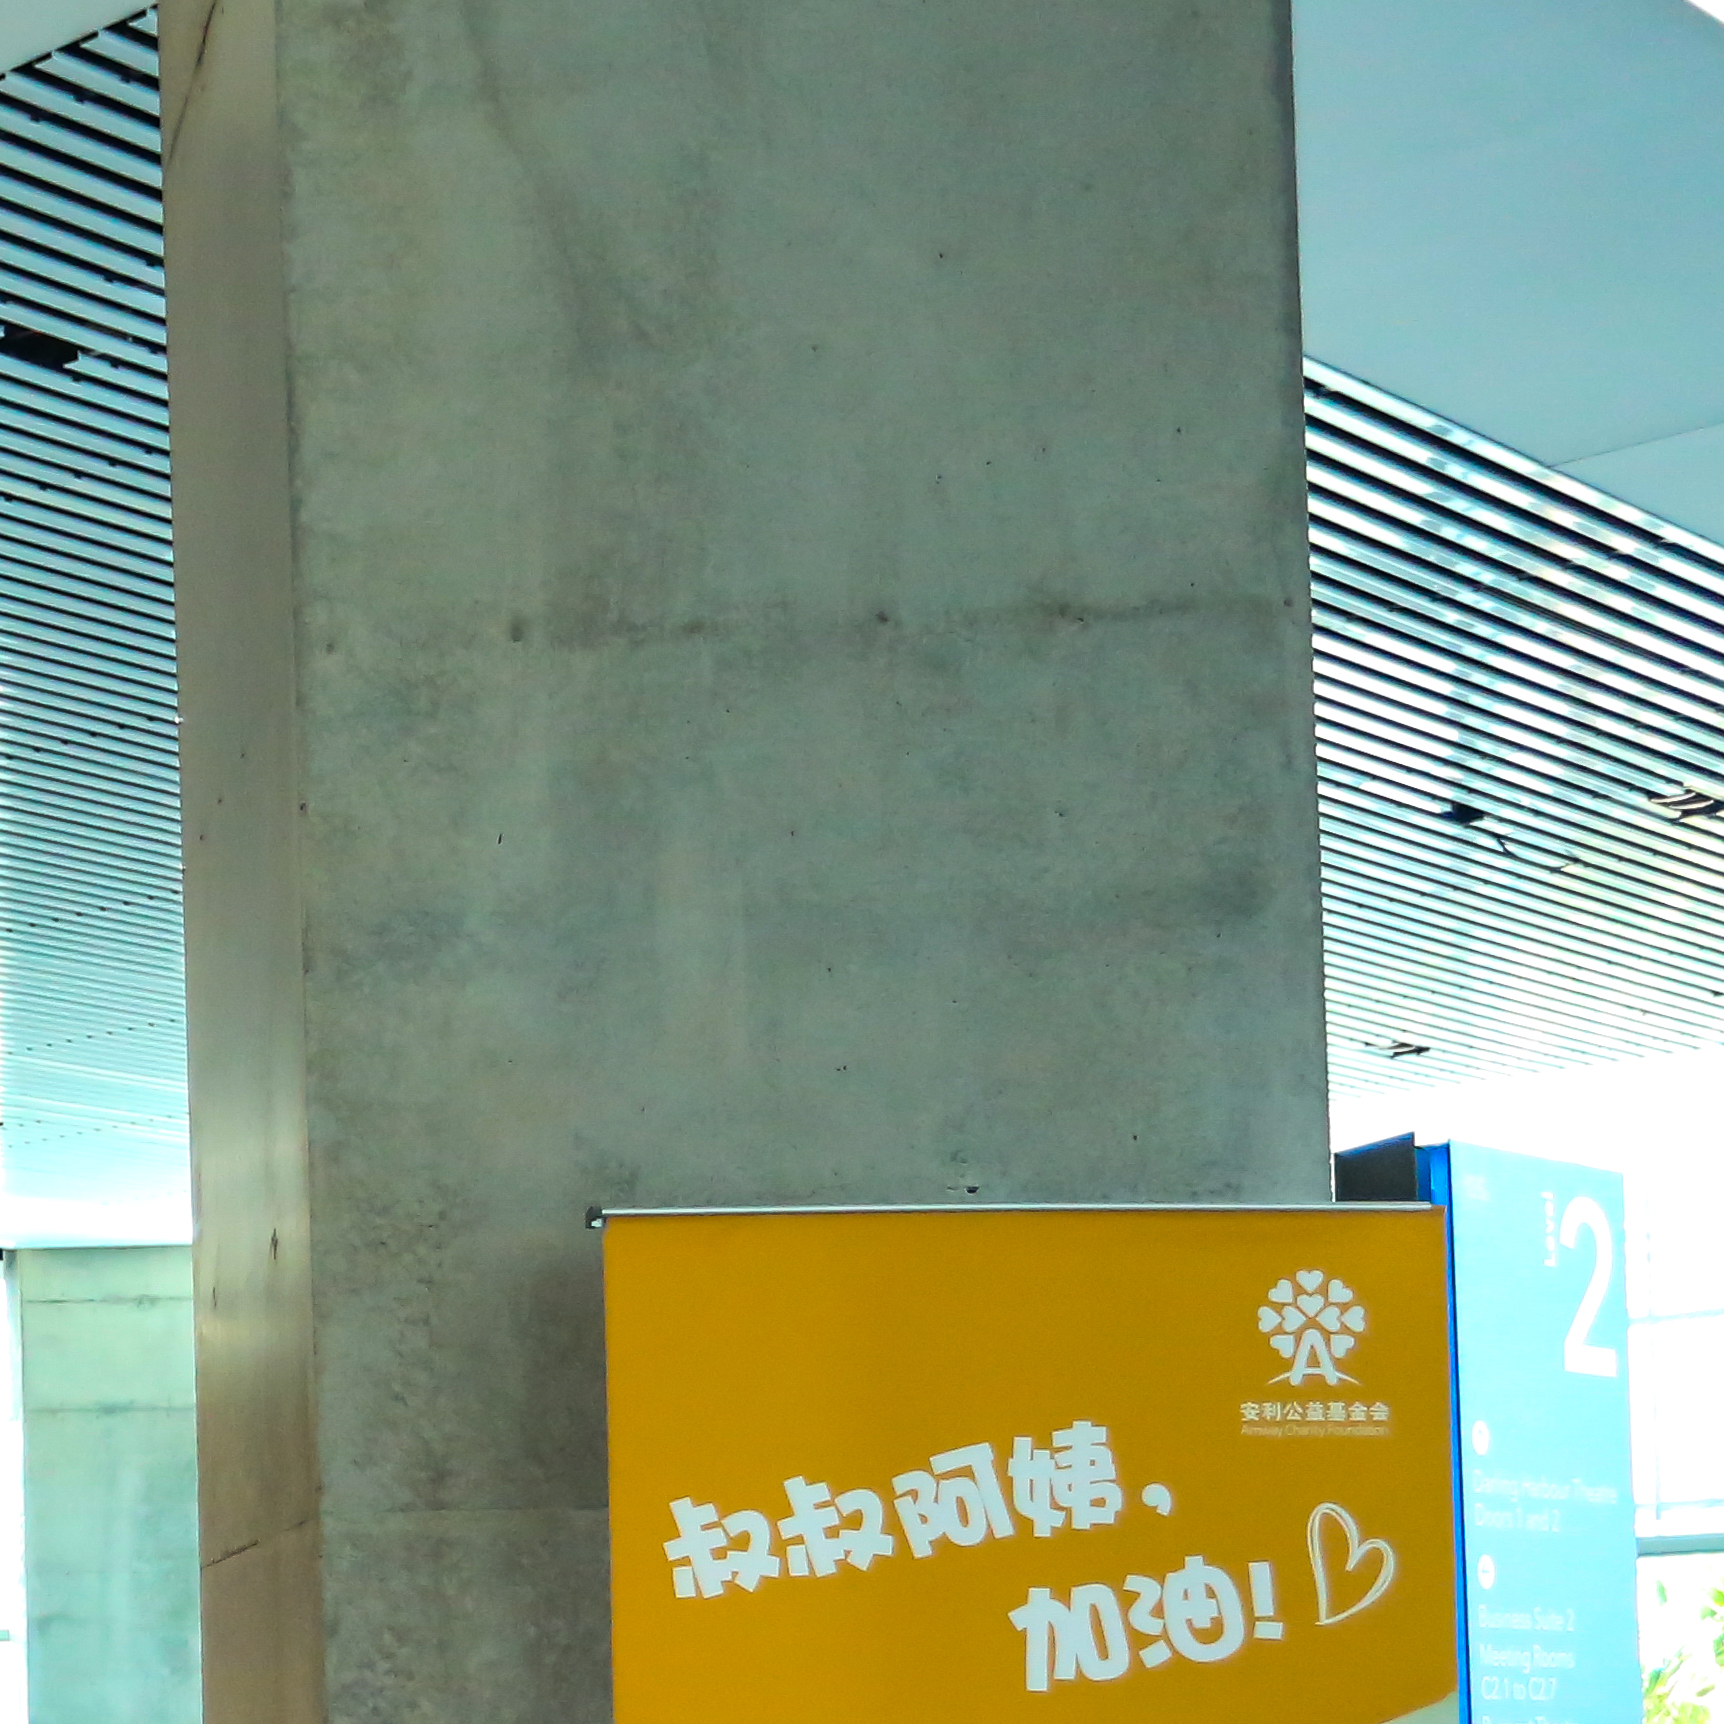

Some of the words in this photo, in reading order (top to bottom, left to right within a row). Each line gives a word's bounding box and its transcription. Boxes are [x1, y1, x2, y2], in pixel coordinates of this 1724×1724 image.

[1559, 1195, 1618, 1378] 2
[1240, 1401, 1390, 1422] 安利公益基金会
